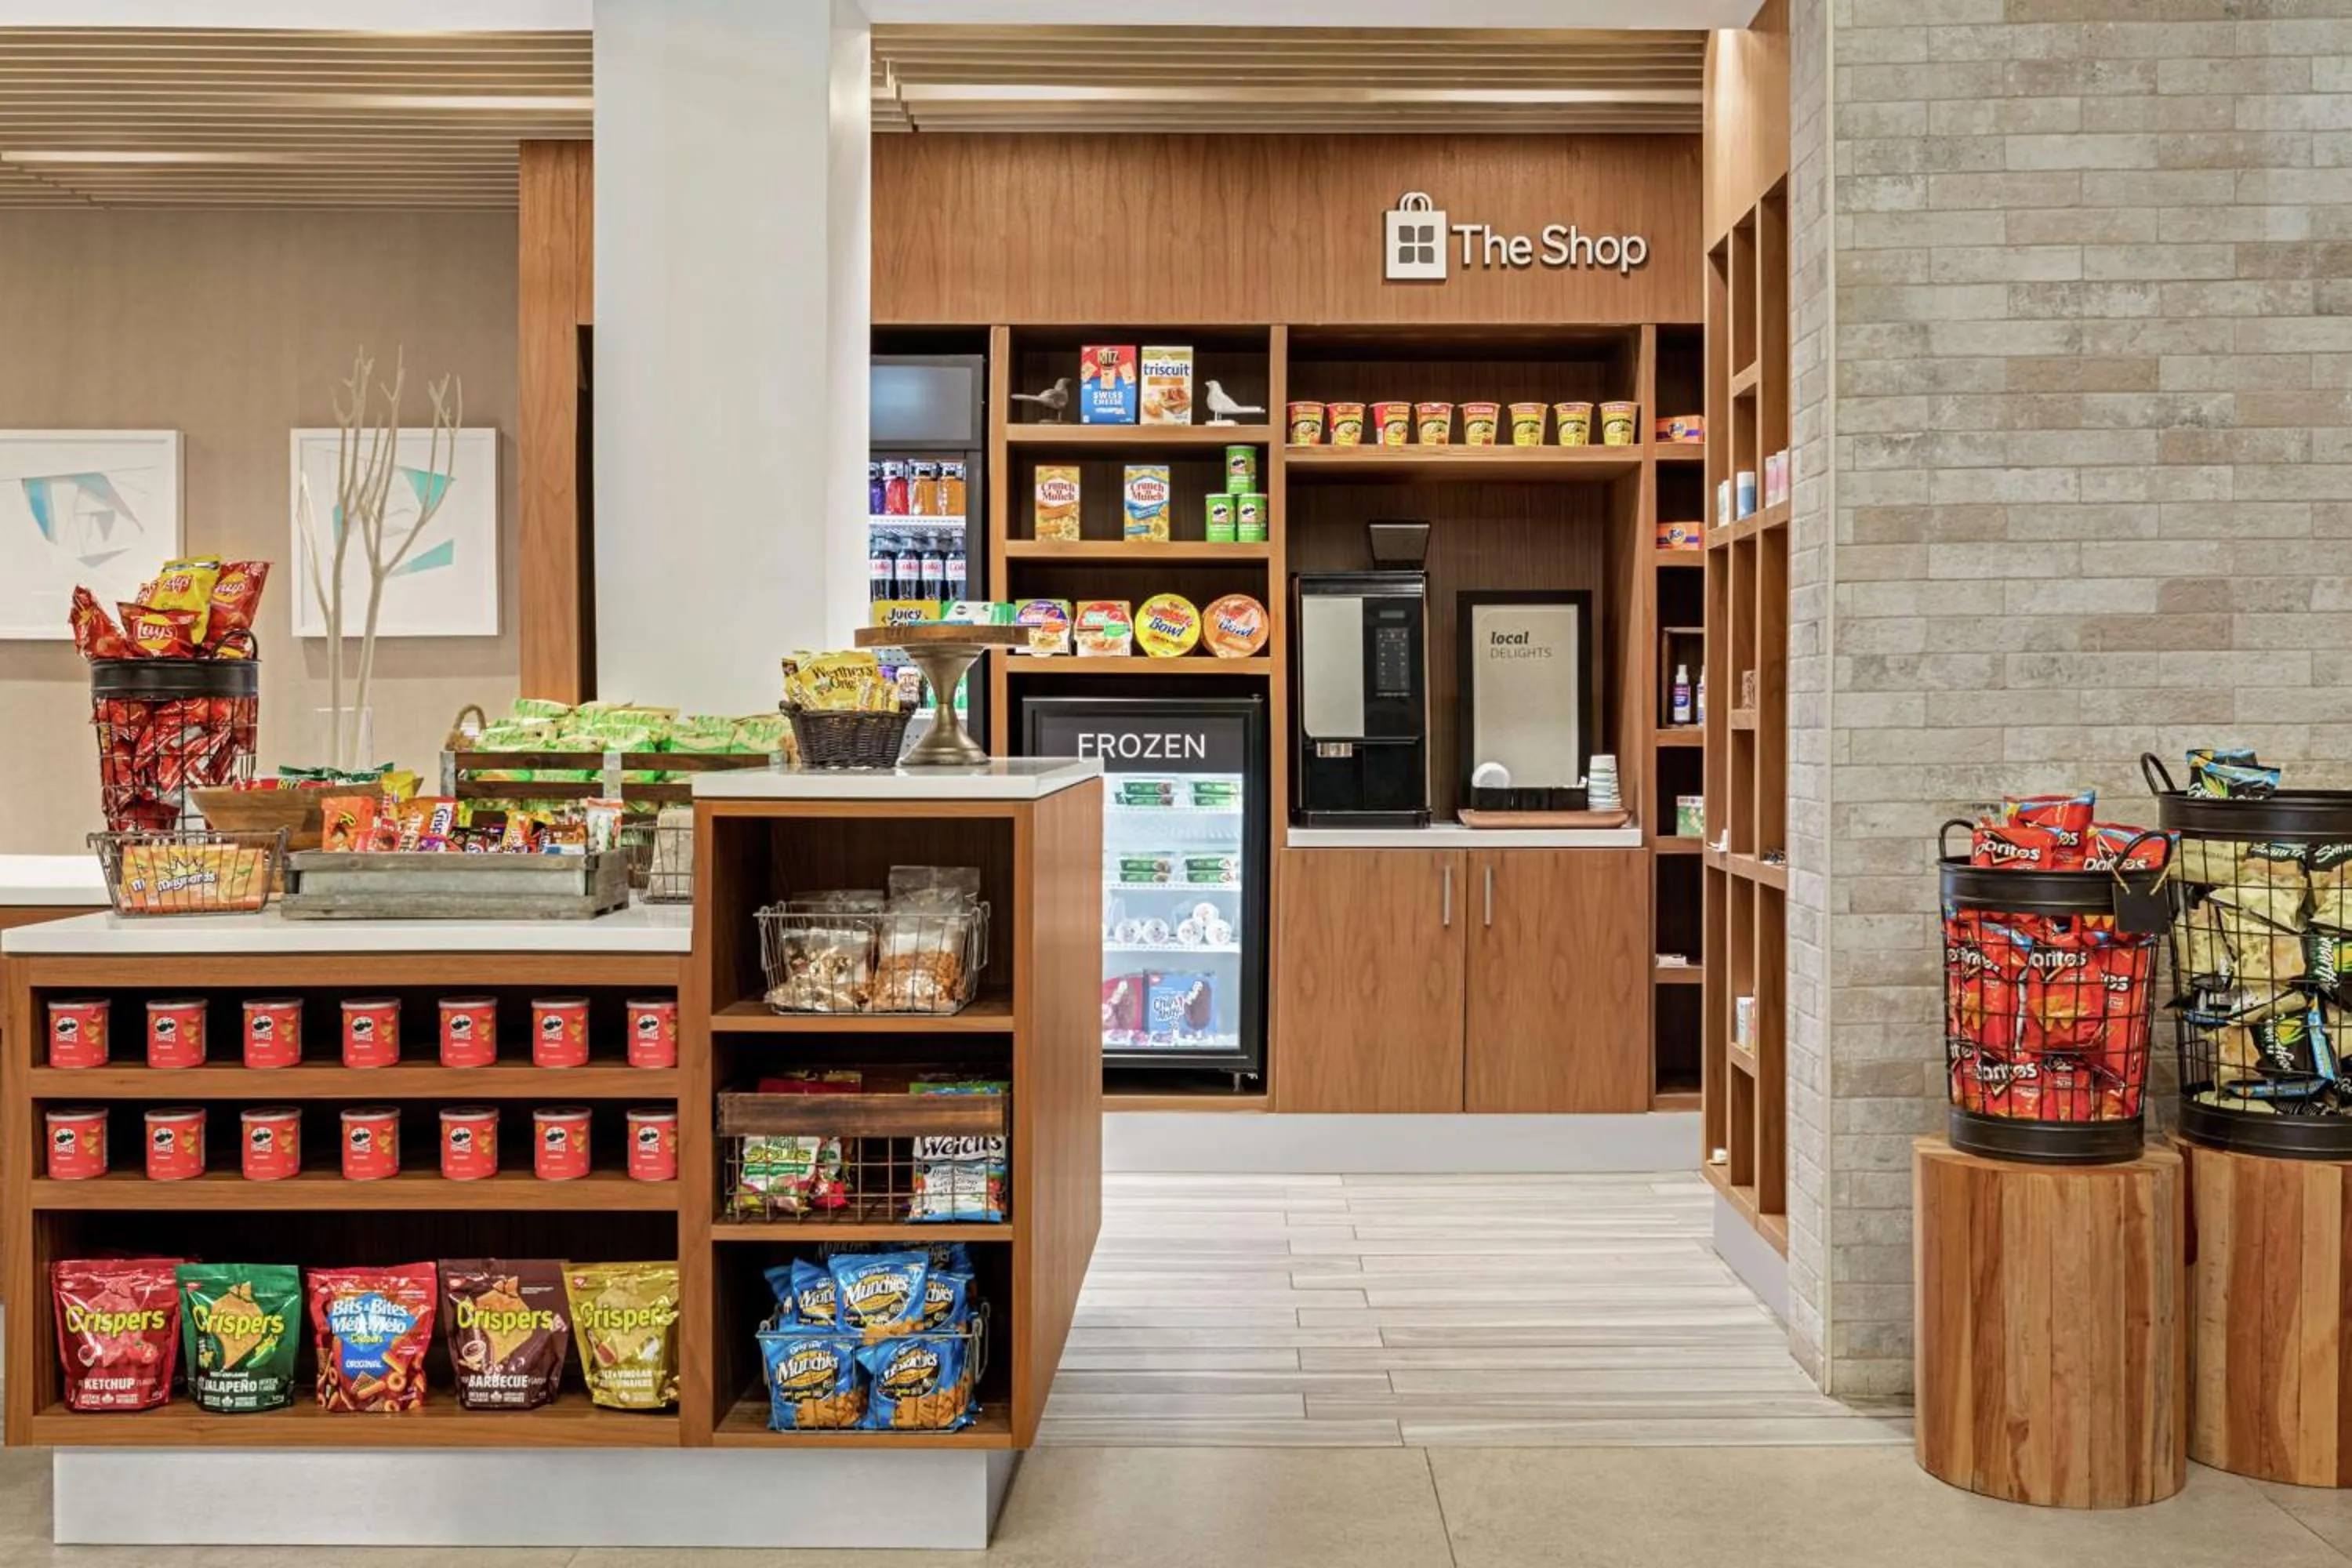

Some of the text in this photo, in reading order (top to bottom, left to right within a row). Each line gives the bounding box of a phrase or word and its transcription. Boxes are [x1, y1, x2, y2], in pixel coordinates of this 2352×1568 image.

[1451, 224, 1647, 274] The Shop
[1143, 363, 1190, 376] triscuit
[1041, 482, 1075, 492] Crunch
[1131, 482, 1164, 492] Crunch
[1043, 492, 1075, 501] Munch
[1132, 492, 1164, 501] Munch
[1149, 615, 1186, 637] Bowl
[1490, 631, 1529, 644] local
[1490, 647, 1552, 659] DELIGHTS
[1077, 733, 1206, 761] FROZEN
[332, 1298, 362, 1316] Bits
[371, 1298, 407, 1316] Bites
[65, 1304, 166, 1336] Crispers
[192, 1304, 285, 1338] Crispers
[457, 1301, 553, 1334] Crispers
[84, 1377, 136, 1390] KETCHUP
[468, 1374, 528, 1388] BARBECUE
